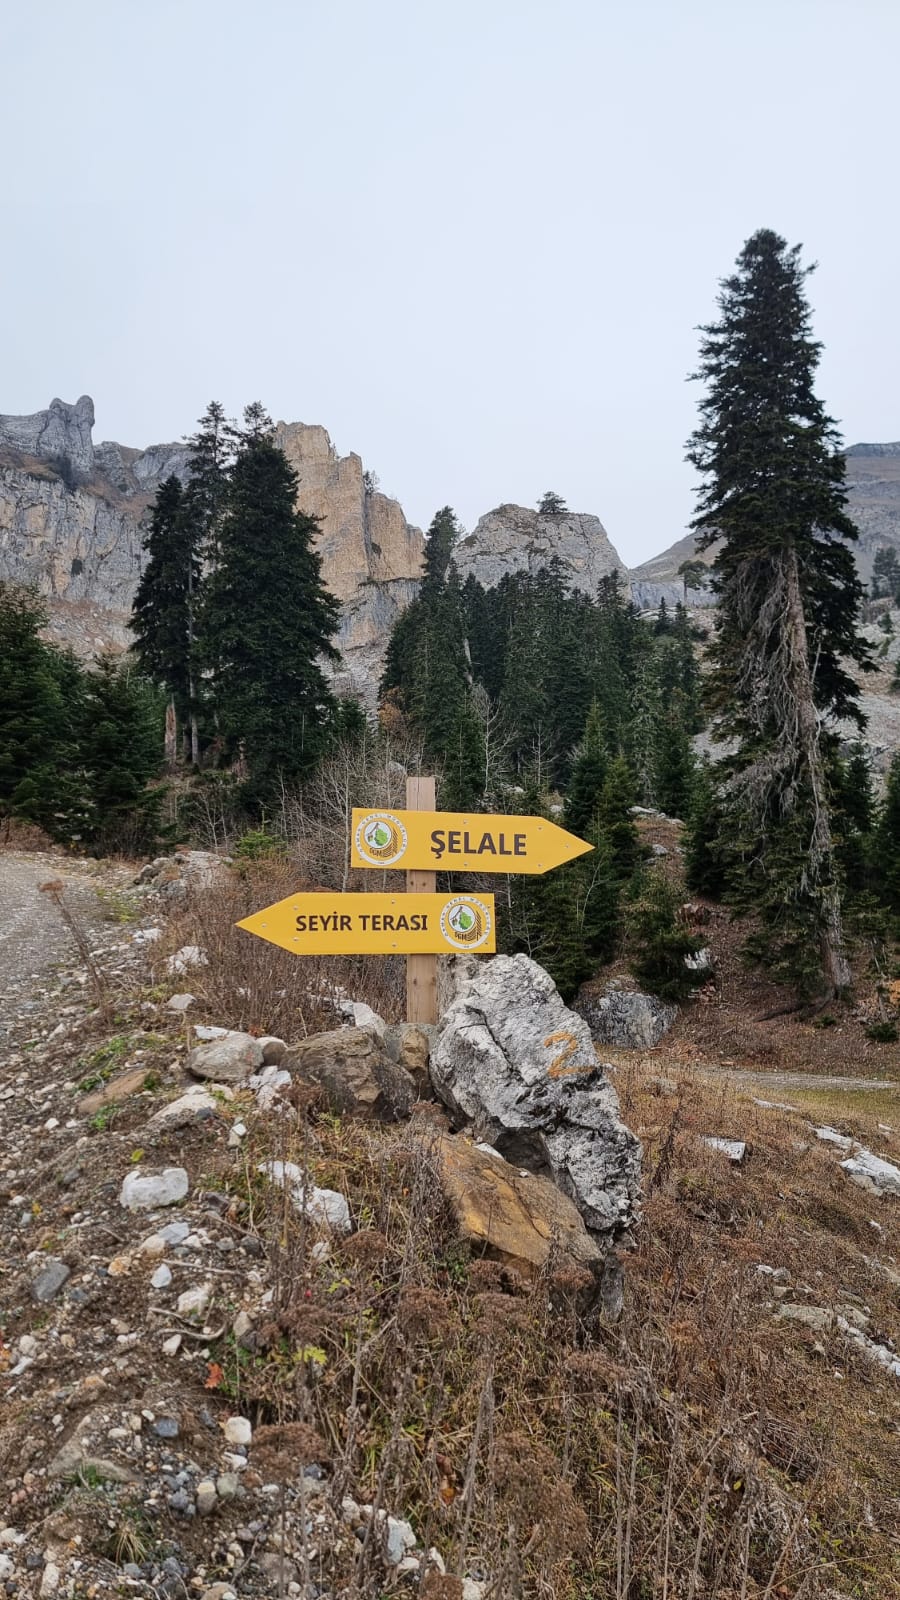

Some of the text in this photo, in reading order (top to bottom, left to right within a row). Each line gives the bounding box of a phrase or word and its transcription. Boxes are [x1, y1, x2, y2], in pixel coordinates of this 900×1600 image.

[430, 829, 527, 859] ŞELALE
[295, 911, 428, 931] SEYİR TERASI
[543, 1031, 596, 1079] 2
